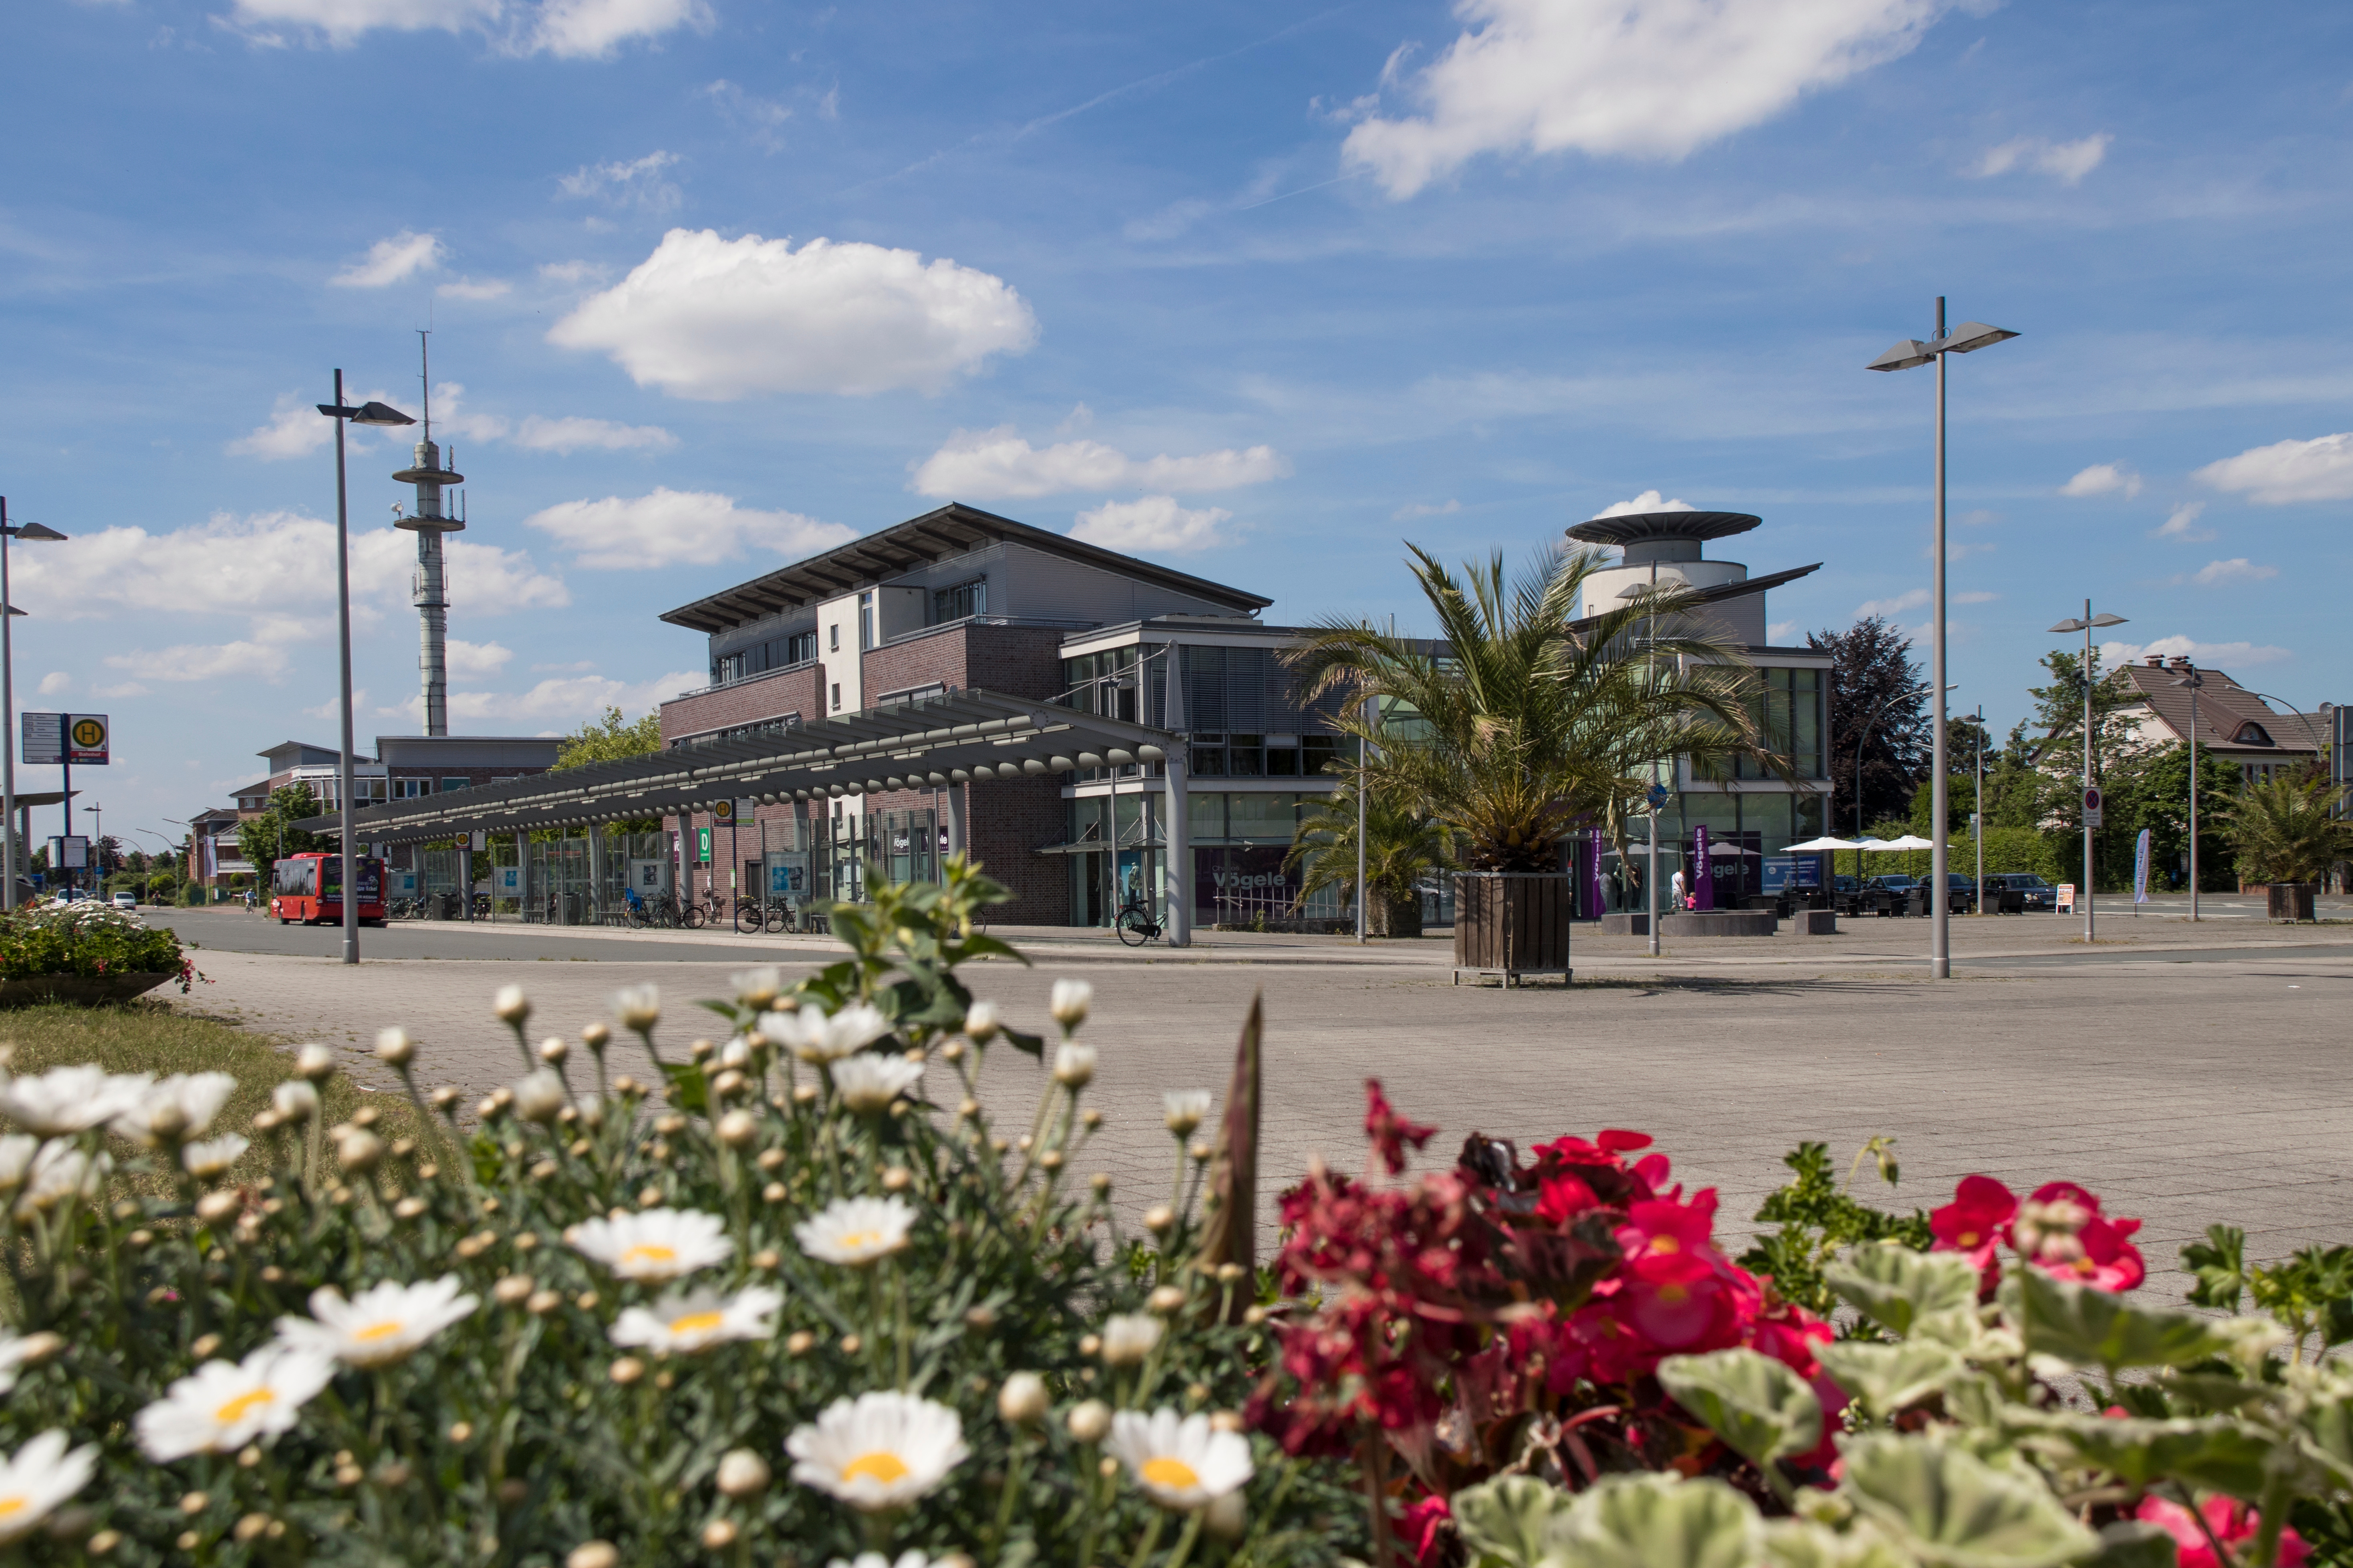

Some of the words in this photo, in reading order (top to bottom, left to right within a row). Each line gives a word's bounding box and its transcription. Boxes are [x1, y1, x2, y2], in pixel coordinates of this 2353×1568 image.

[82, 726, 95, 741] H
[720, 805, 726, 814] H
[702, 833, 708, 851] D
[894, 837, 909, 848] ögel
[1213, 872, 1286, 890] Vögele
